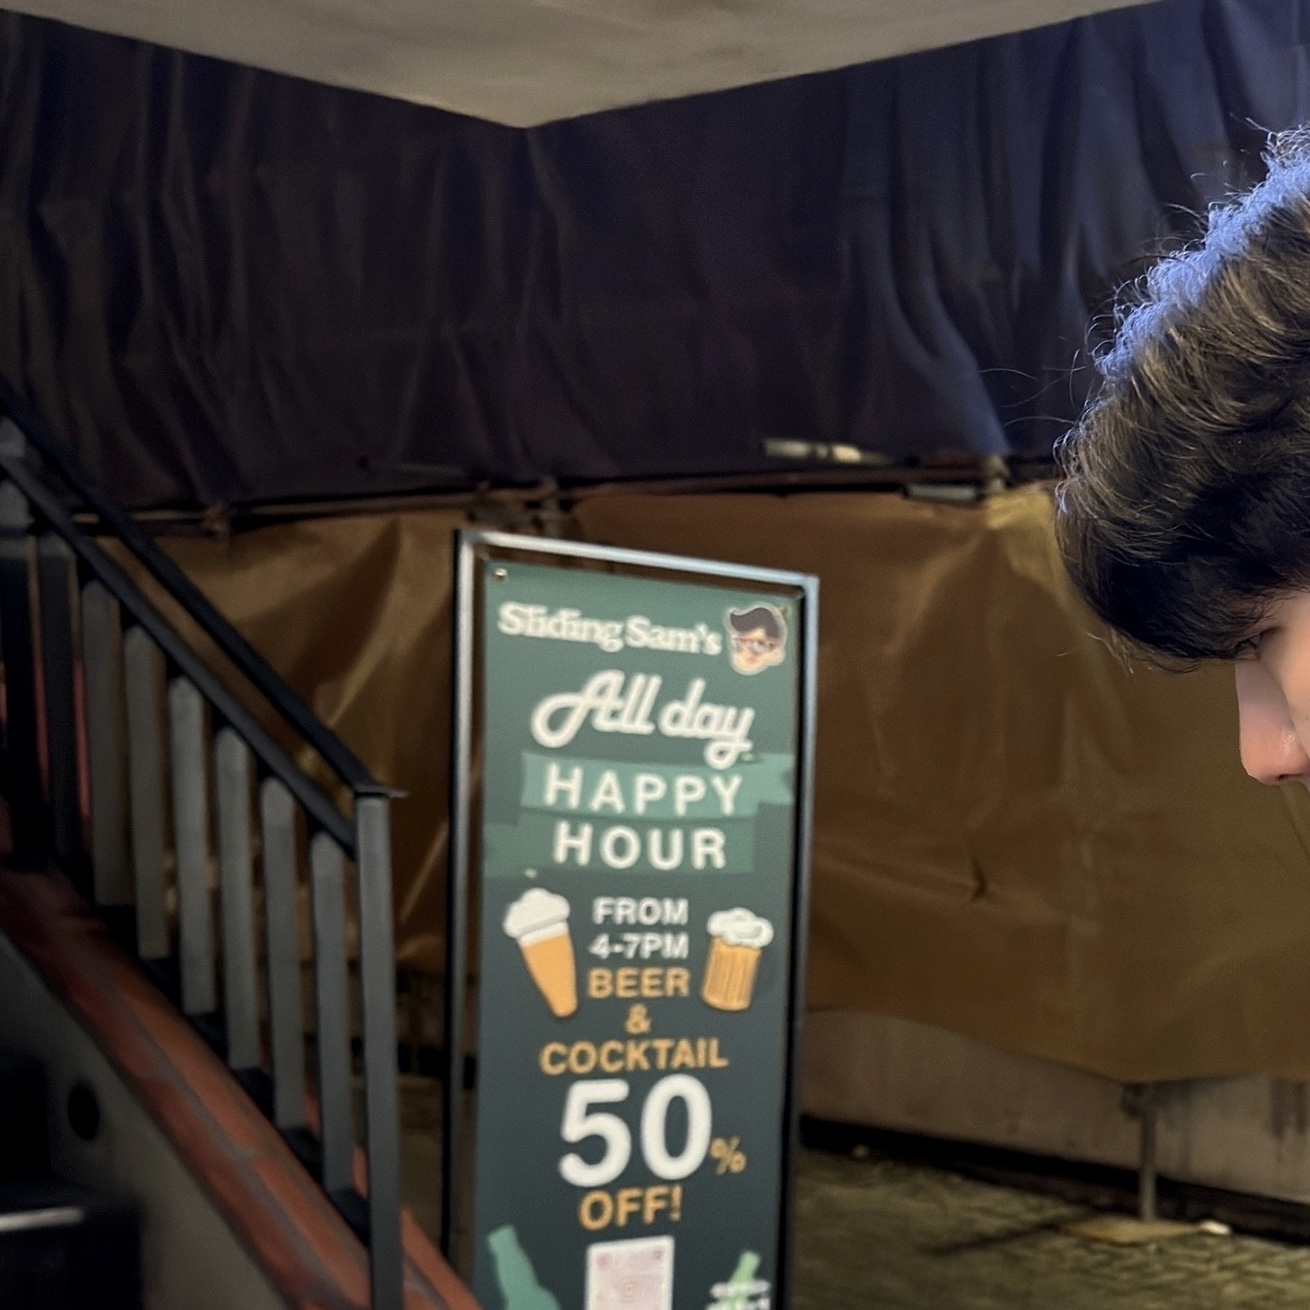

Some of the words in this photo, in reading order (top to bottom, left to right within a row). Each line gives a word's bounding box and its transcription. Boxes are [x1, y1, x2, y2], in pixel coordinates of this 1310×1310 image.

[497, 600, 624, 652] Sliding
[625, 616, 722, 655] Sam's
[530, 669, 661, 748] All
[660, 677, 755, 770] day
[543, 764, 742, 815] HAPPY
[553, 821, 727, 869] HOUR
[592, 897, 689, 926] FROM
[587, 932, 689, 961] 4-7PM
[587, 967, 690, 1000] BEER
[625, 1004, 651, 1034] &
[539, 1037, 728, 1076] COCKTAIL
[579, 1185, 683, 1230] OFF!
